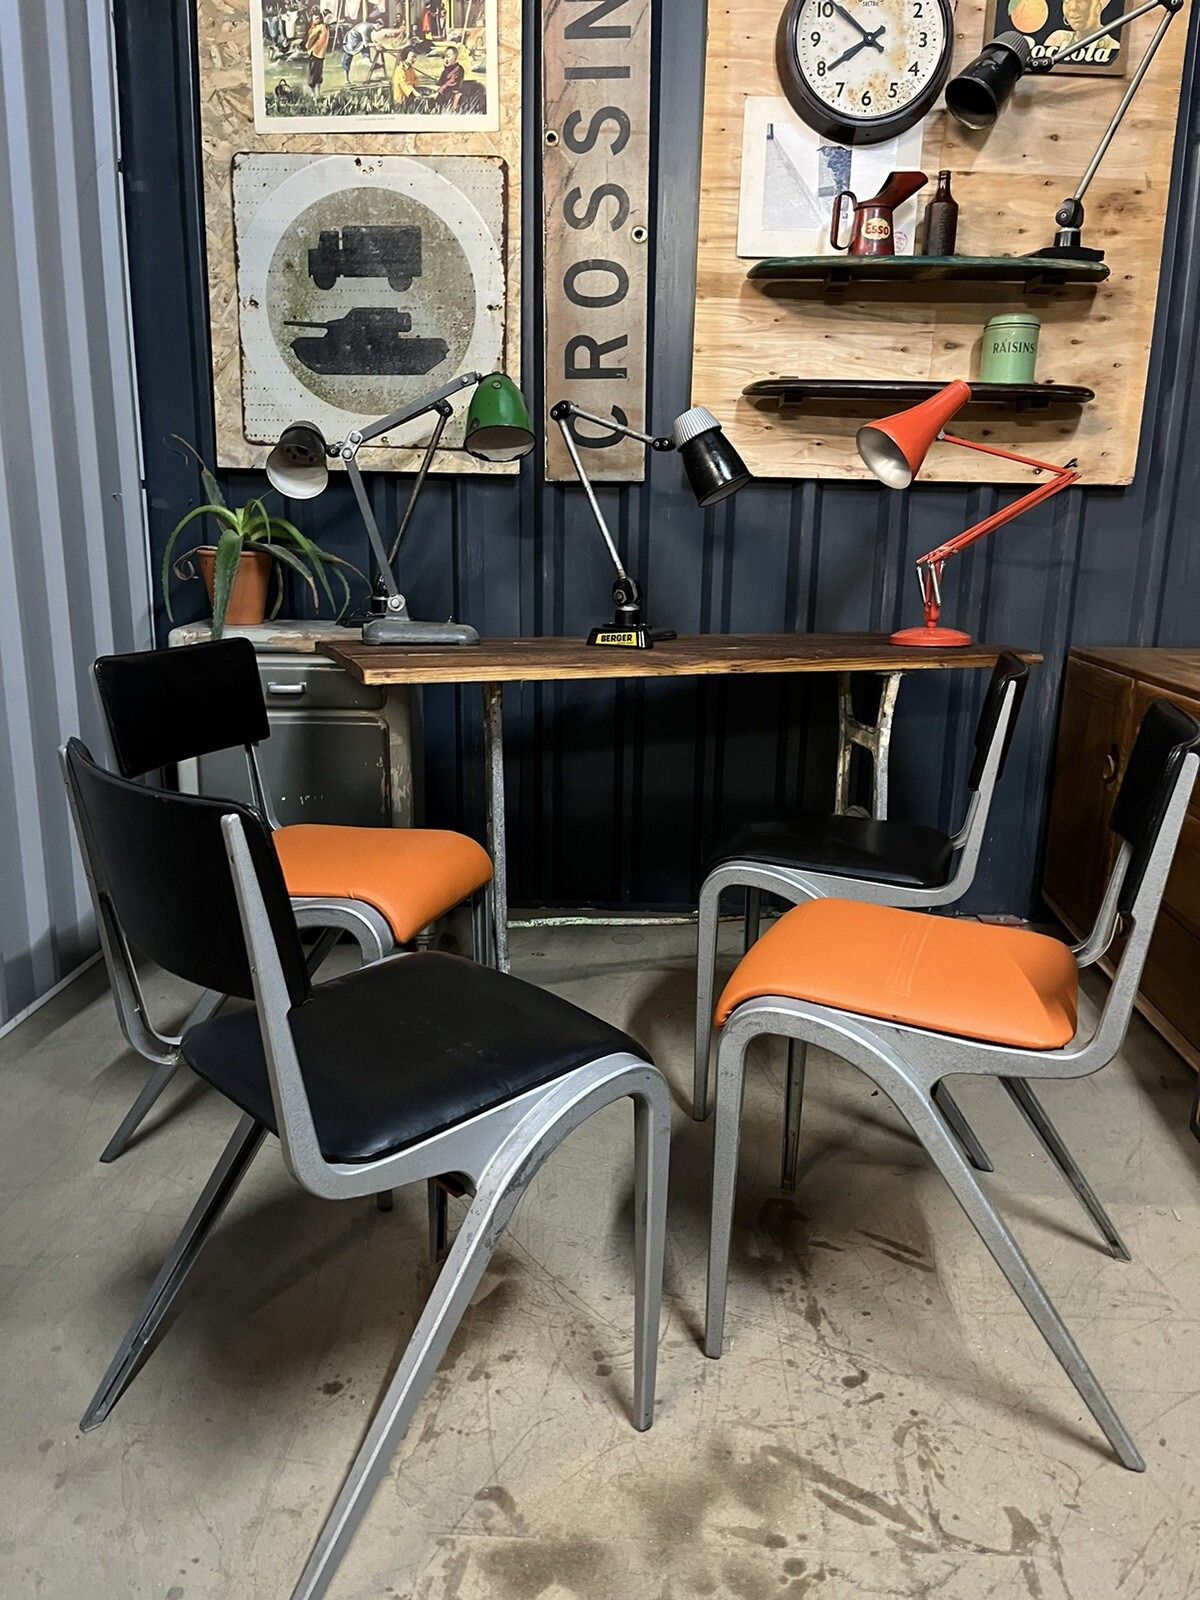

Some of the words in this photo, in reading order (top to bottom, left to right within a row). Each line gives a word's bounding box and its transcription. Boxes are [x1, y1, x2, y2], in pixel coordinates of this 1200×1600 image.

[817, 2, 834, 17] 10
[913, 3, 923, 18] 2
[811, 32, 821, 47] 9
[919, 33, 927, 48] 3
[817, 61, 826, 76] 8
[908, 61, 919, 76] 4
[836, 82, 845, 97] 7
[888, 83, 898, 98] 5
[861, 91, 871, 106] 6
[993, 341, 1036, 354] RAISINS
[600, 634, 633, 642] BERGER
